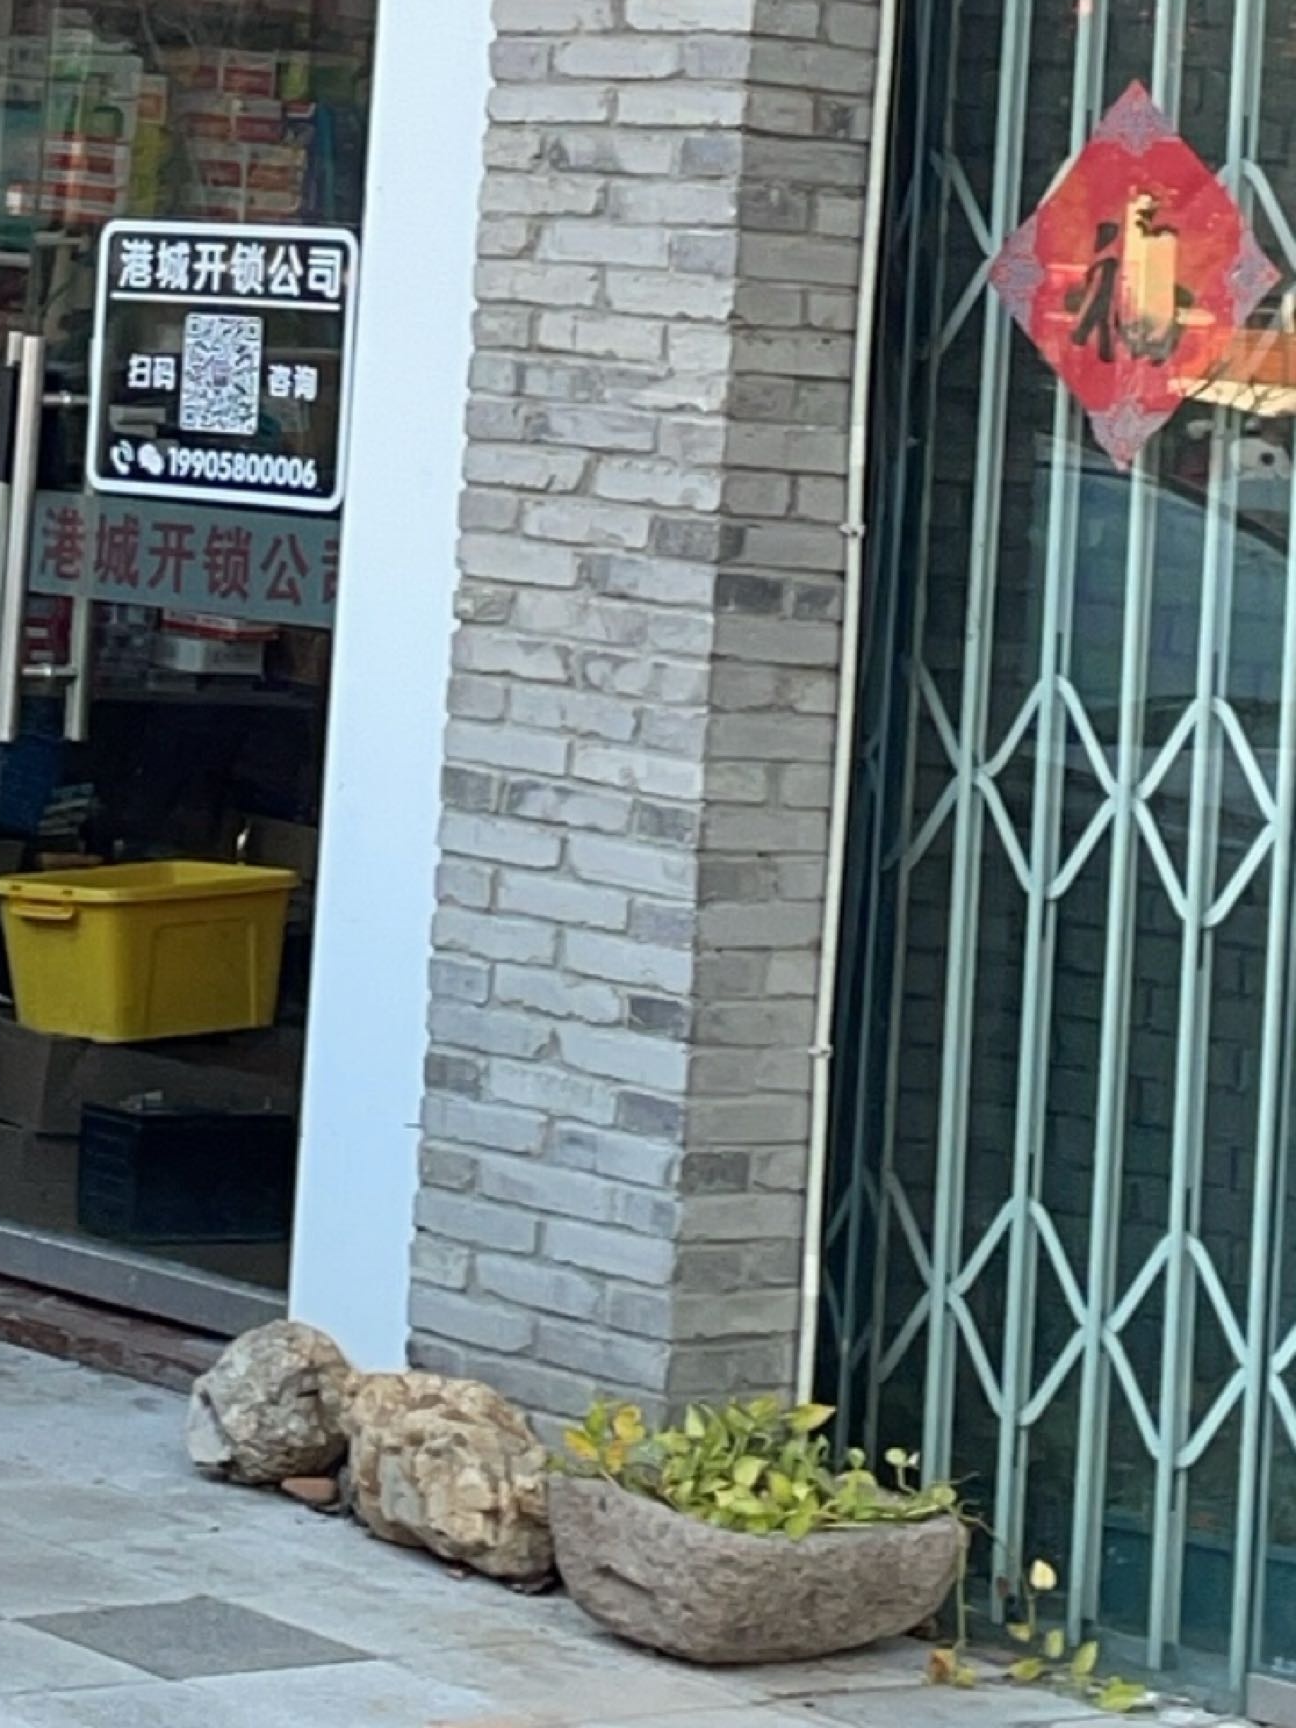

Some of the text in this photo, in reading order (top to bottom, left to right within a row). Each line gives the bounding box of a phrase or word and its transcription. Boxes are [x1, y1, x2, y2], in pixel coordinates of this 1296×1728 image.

[119, 238, 343, 298] 港城开锁公司
[168, 447, 317, 489] 19905800006
